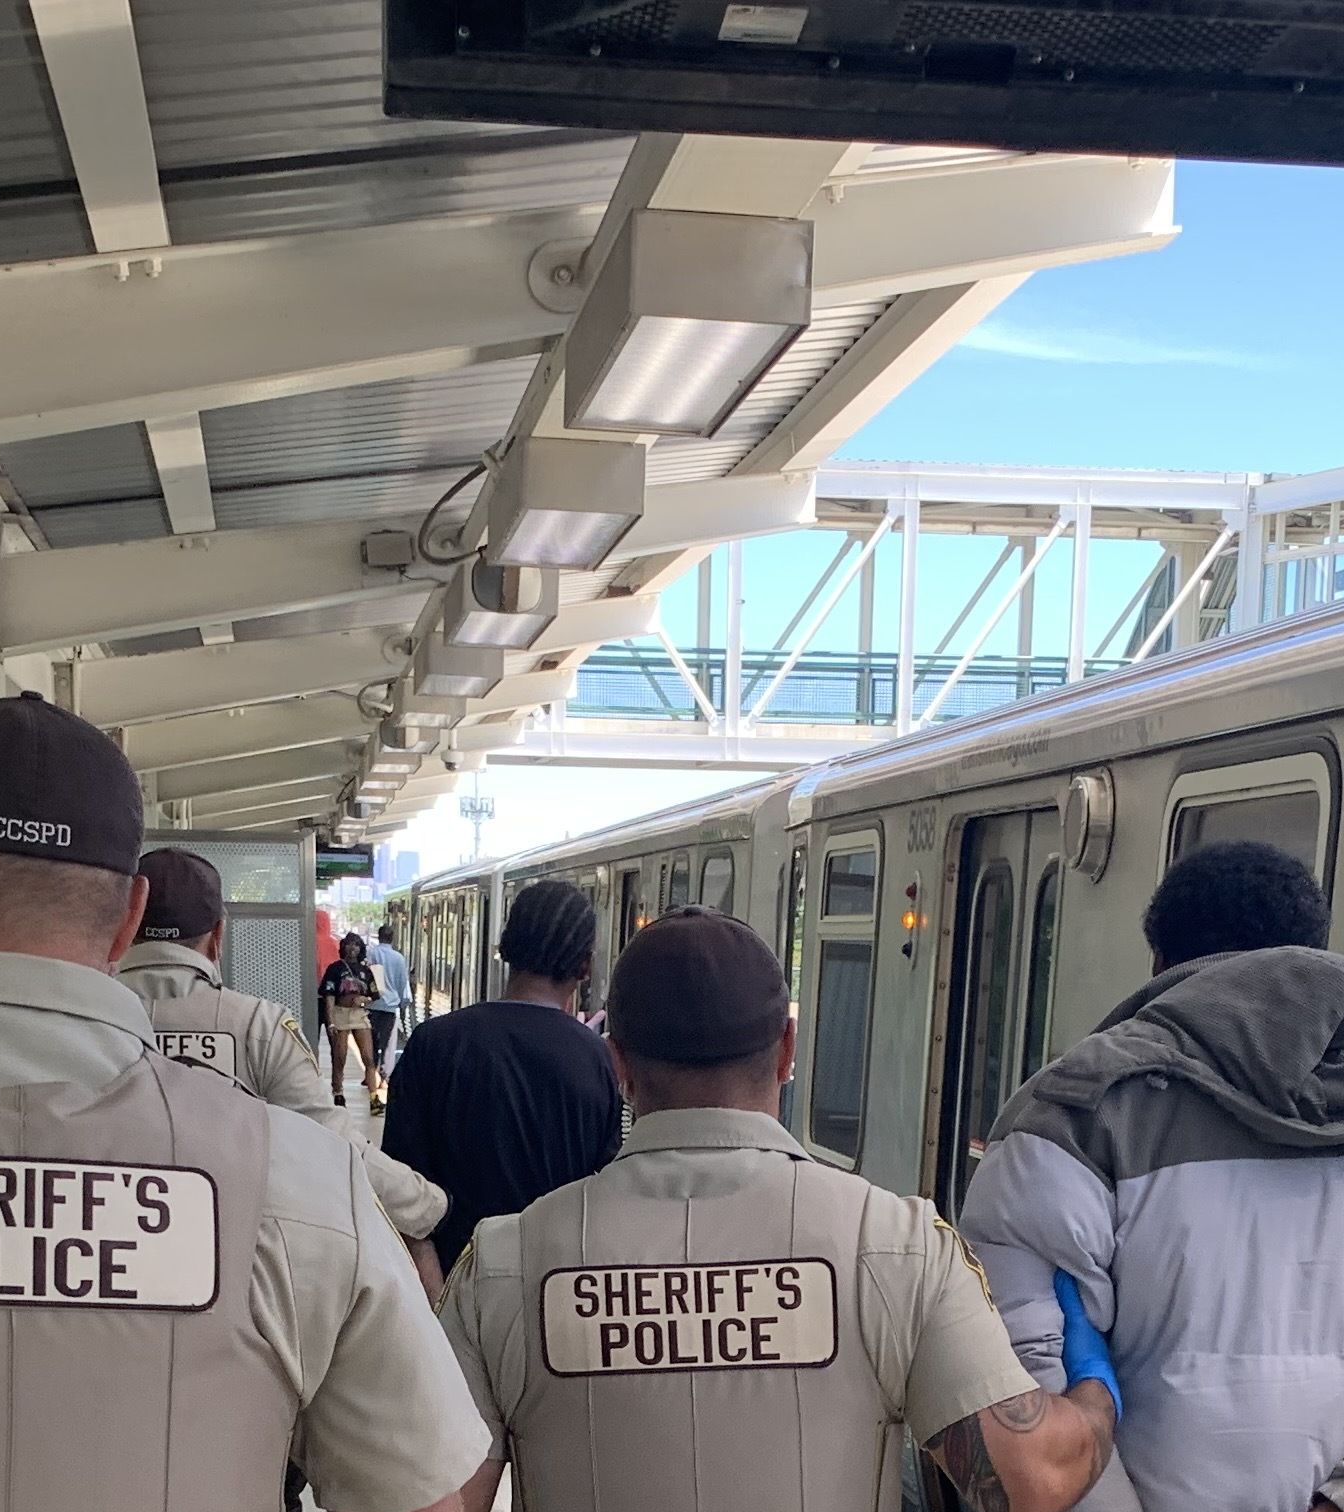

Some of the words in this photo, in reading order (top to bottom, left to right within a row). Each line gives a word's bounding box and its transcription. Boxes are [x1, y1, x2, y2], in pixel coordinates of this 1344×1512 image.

[145, 926, 180, 938] CCSPD
[573, 1266, 802, 1318] SHERIFF'S
[600, 1316, 781, 1368] POLICE
